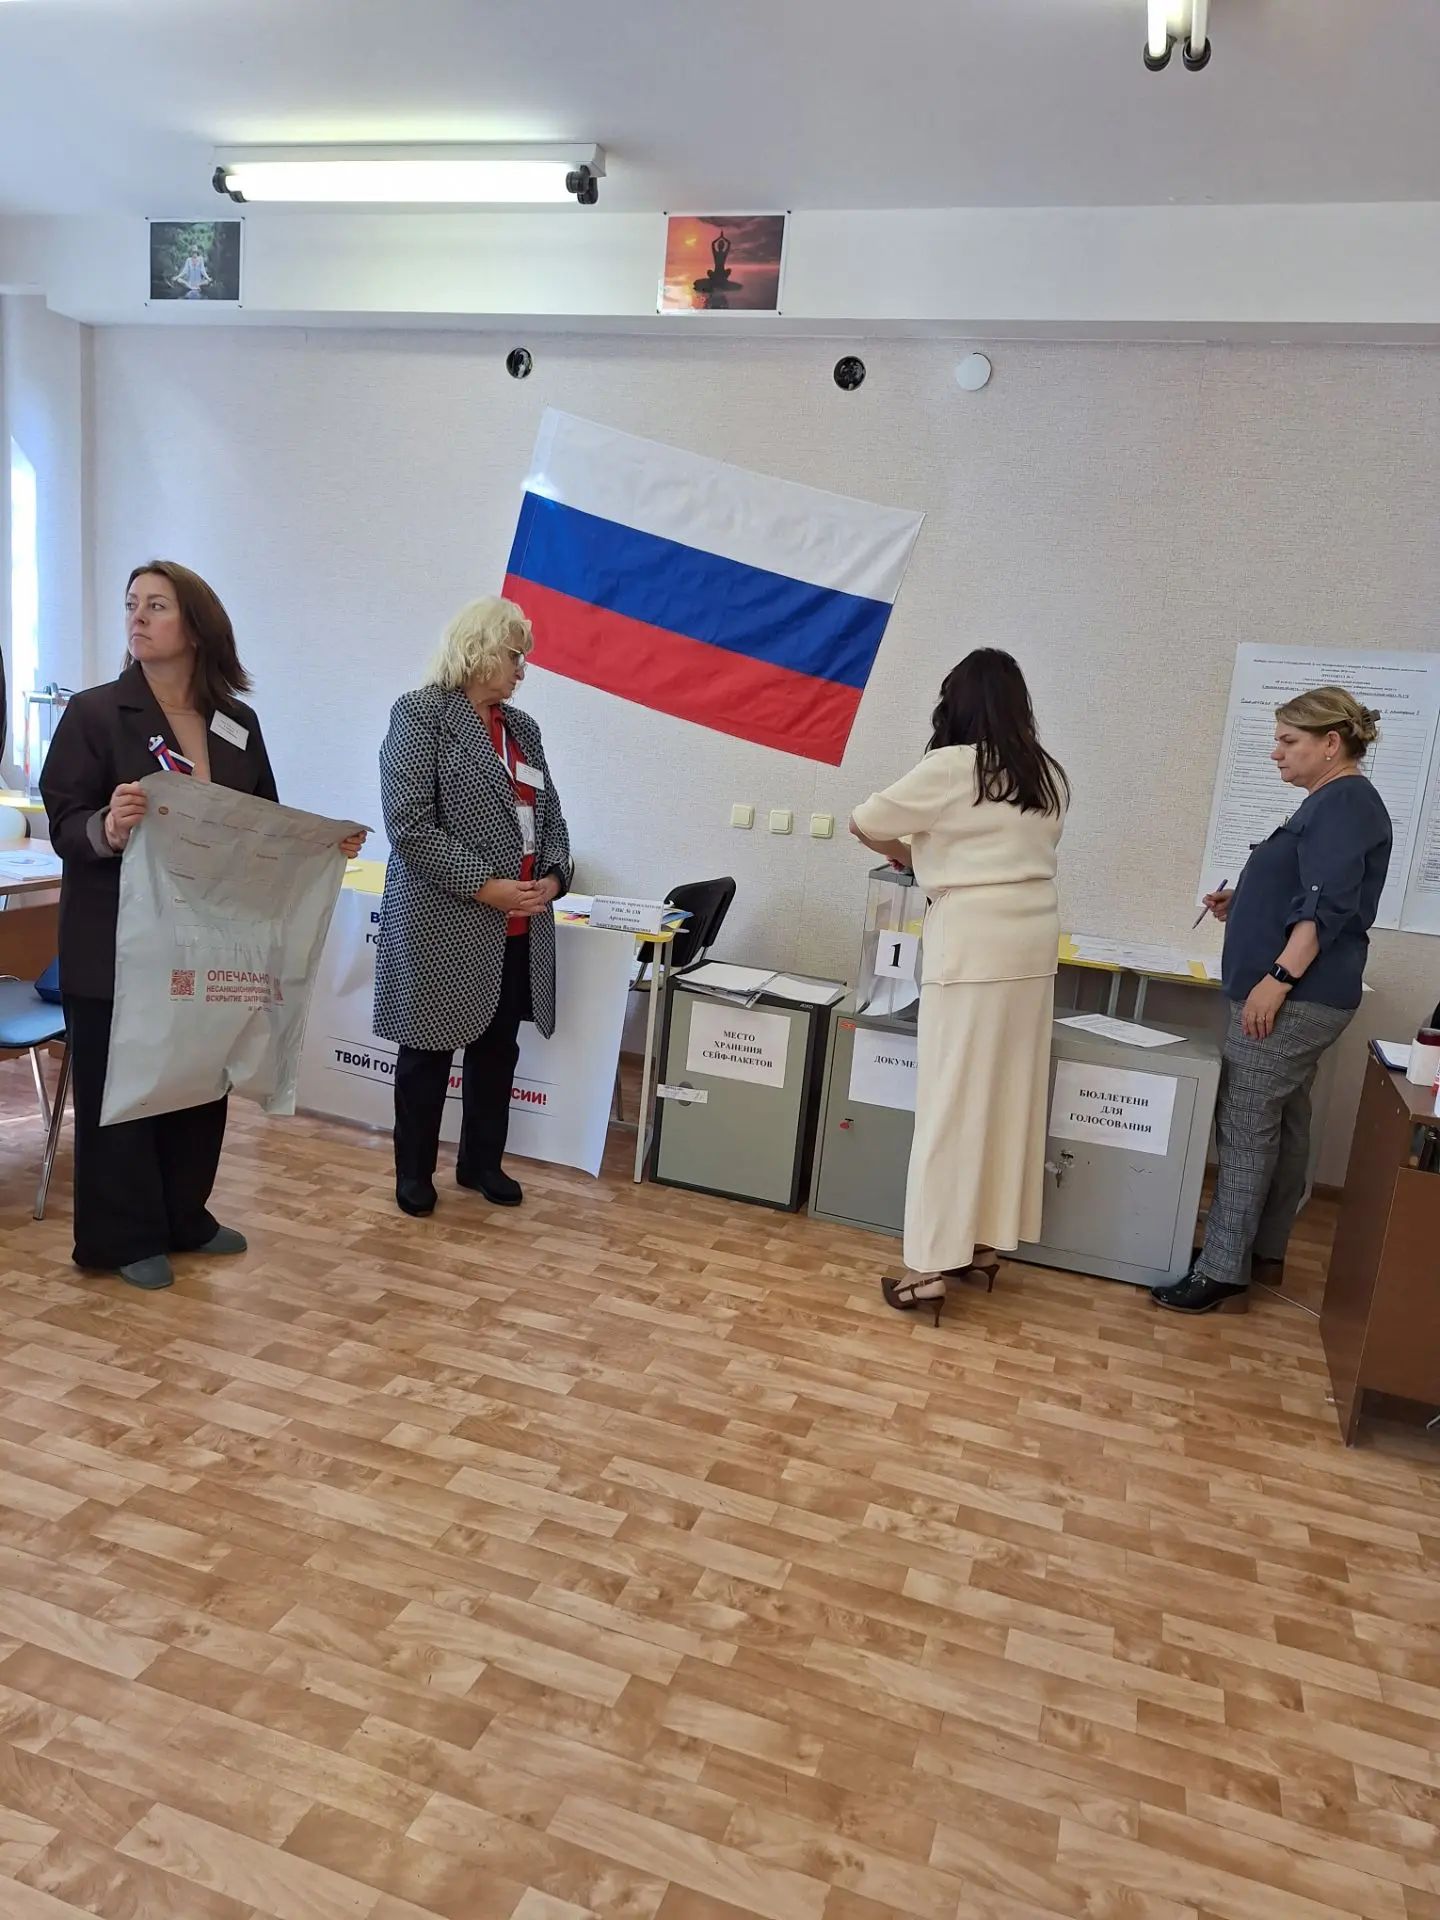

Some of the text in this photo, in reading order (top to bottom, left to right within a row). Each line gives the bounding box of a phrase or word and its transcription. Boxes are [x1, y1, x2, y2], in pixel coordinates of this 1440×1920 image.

[889, 943, 901, 968] 1
[207, 970, 270, 985] ОПЕЧАТАНО
[206, 994, 242, 1003] ВСКРЫТИЕ
[723, 1030, 756, 1042] МЕСТО
[714, 1040, 763, 1055] ХРАНЕНИЯ
[702, 1049, 773, 1068] СЕЙФ-ПАКЕТОВ
[335, 1049, 371, 1069] ТВОЙ
[373, 1059, 397, 1075] ГОЛ
[511, 1087, 546, 1105] СИИ!
[1079, 1089, 1149, 1107] БЮЛЛЕТЕНИ
[1100, 1105, 1123, 1116] ДЛЯ
[1069, 1113, 1152, 1133] ГОЛОСОВАНИЯ
